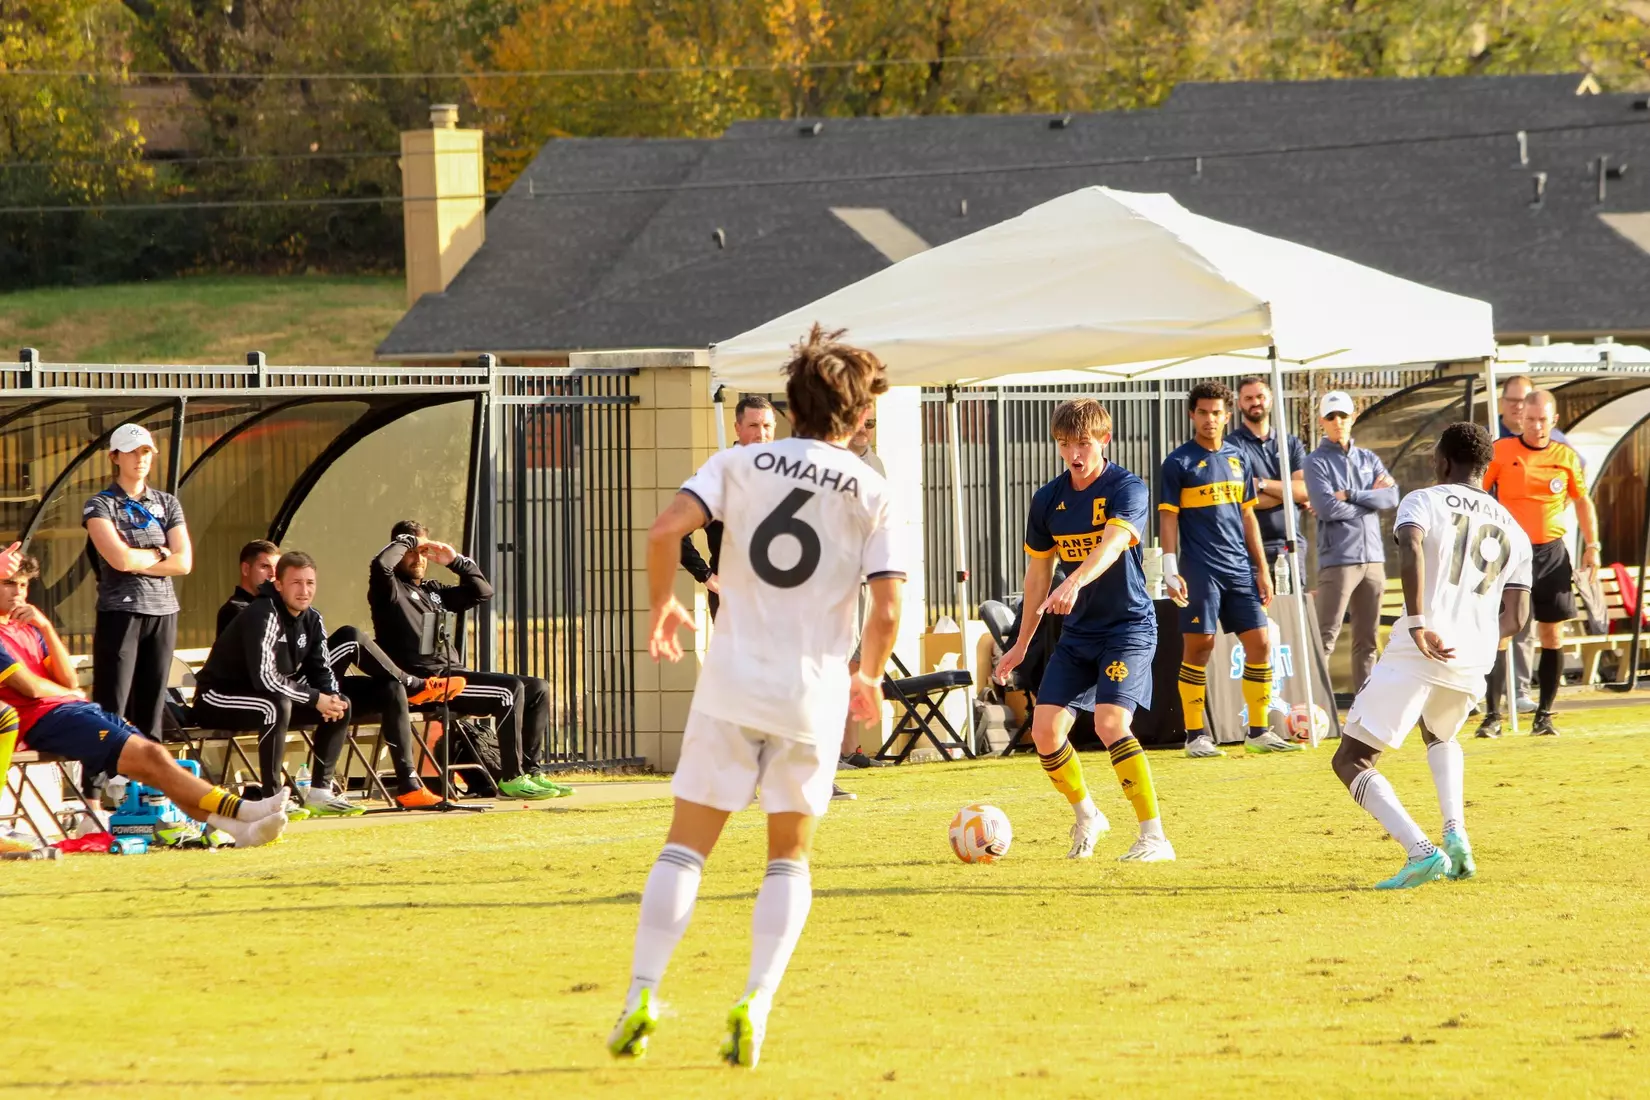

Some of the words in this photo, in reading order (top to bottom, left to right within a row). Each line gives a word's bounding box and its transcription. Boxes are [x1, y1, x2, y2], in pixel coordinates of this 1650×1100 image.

[754, 452, 859, 498] OMAHA
[748, 487, 821, 589] 6
[1067, 547, 1098, 558] CIT
[1447, 511, 1511, 596] 19
[111, 825, 154, 835] POWERADE
